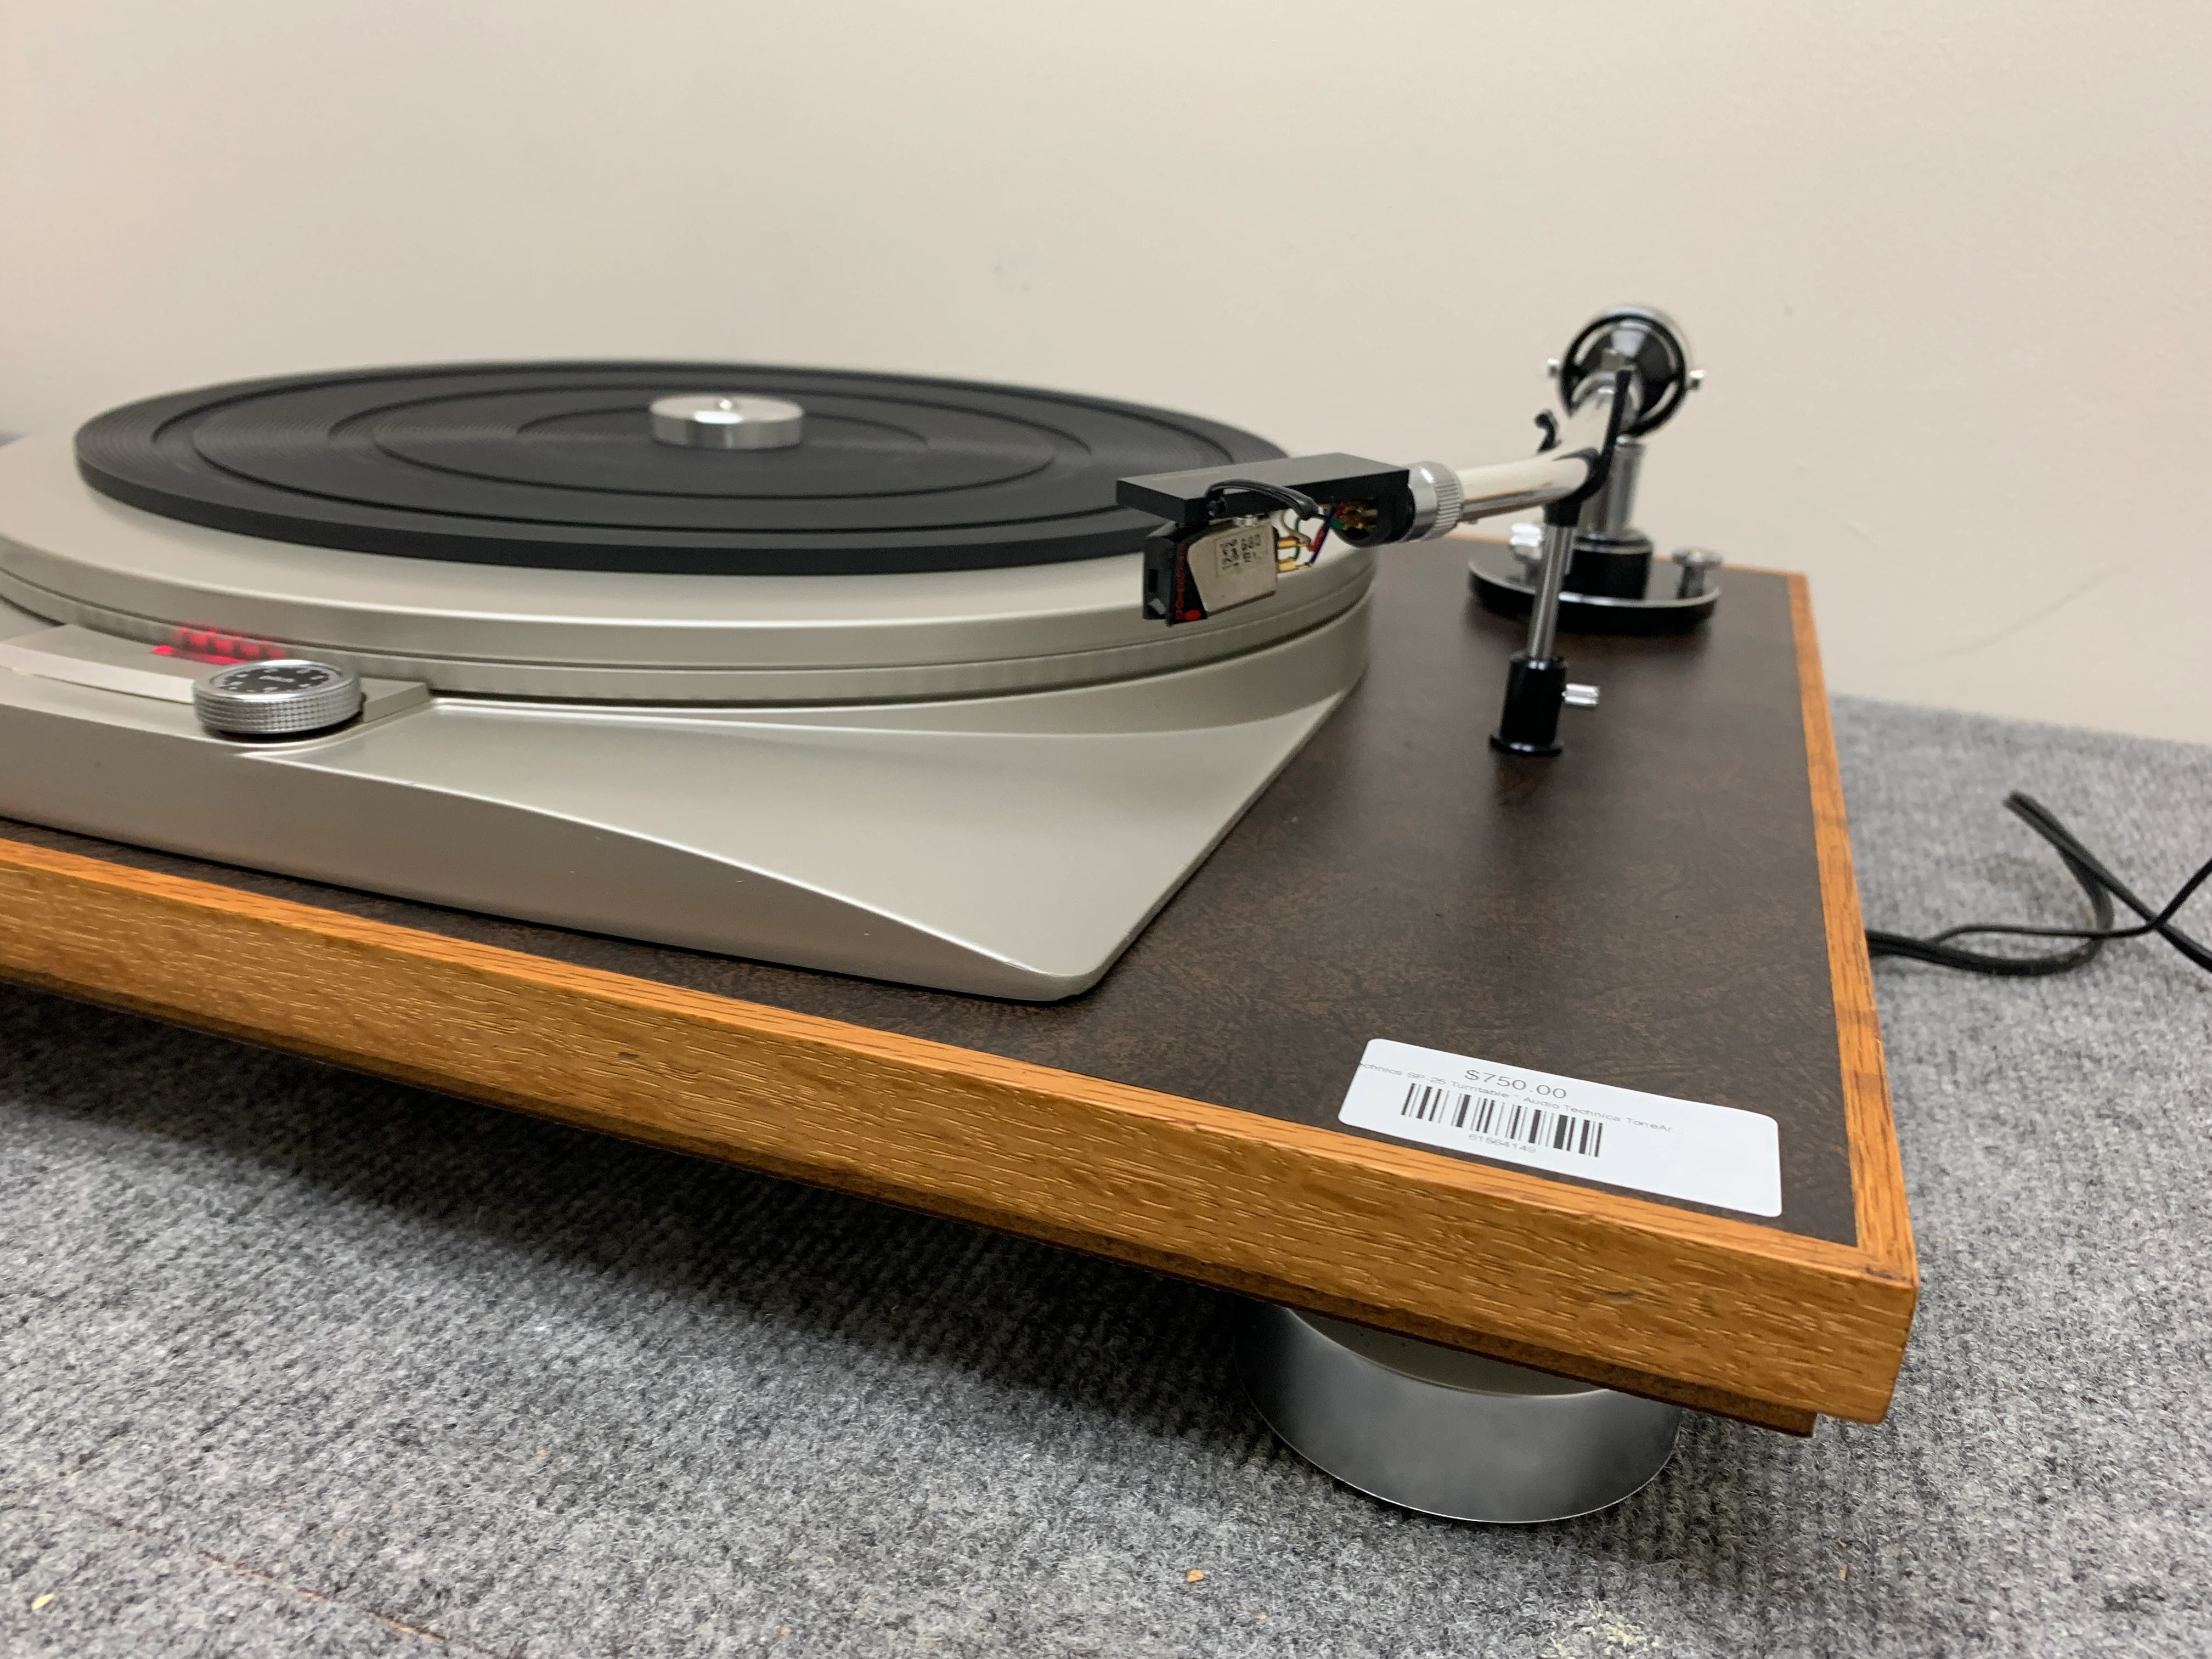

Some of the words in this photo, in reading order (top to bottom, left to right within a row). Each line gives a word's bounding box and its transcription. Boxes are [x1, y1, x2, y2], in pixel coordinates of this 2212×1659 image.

[1407, 1071, 1446, 1085] SP-25
[1451, 1080, 1509, 1098] Turntable
[1523, 1097, 1560, 1109] Audio
[1564, 1104, 1621, 1122] Technica
[1464, 1069, 1567, 1098] $750.00
[1468, 1133, 1537, 1154] 61564149
